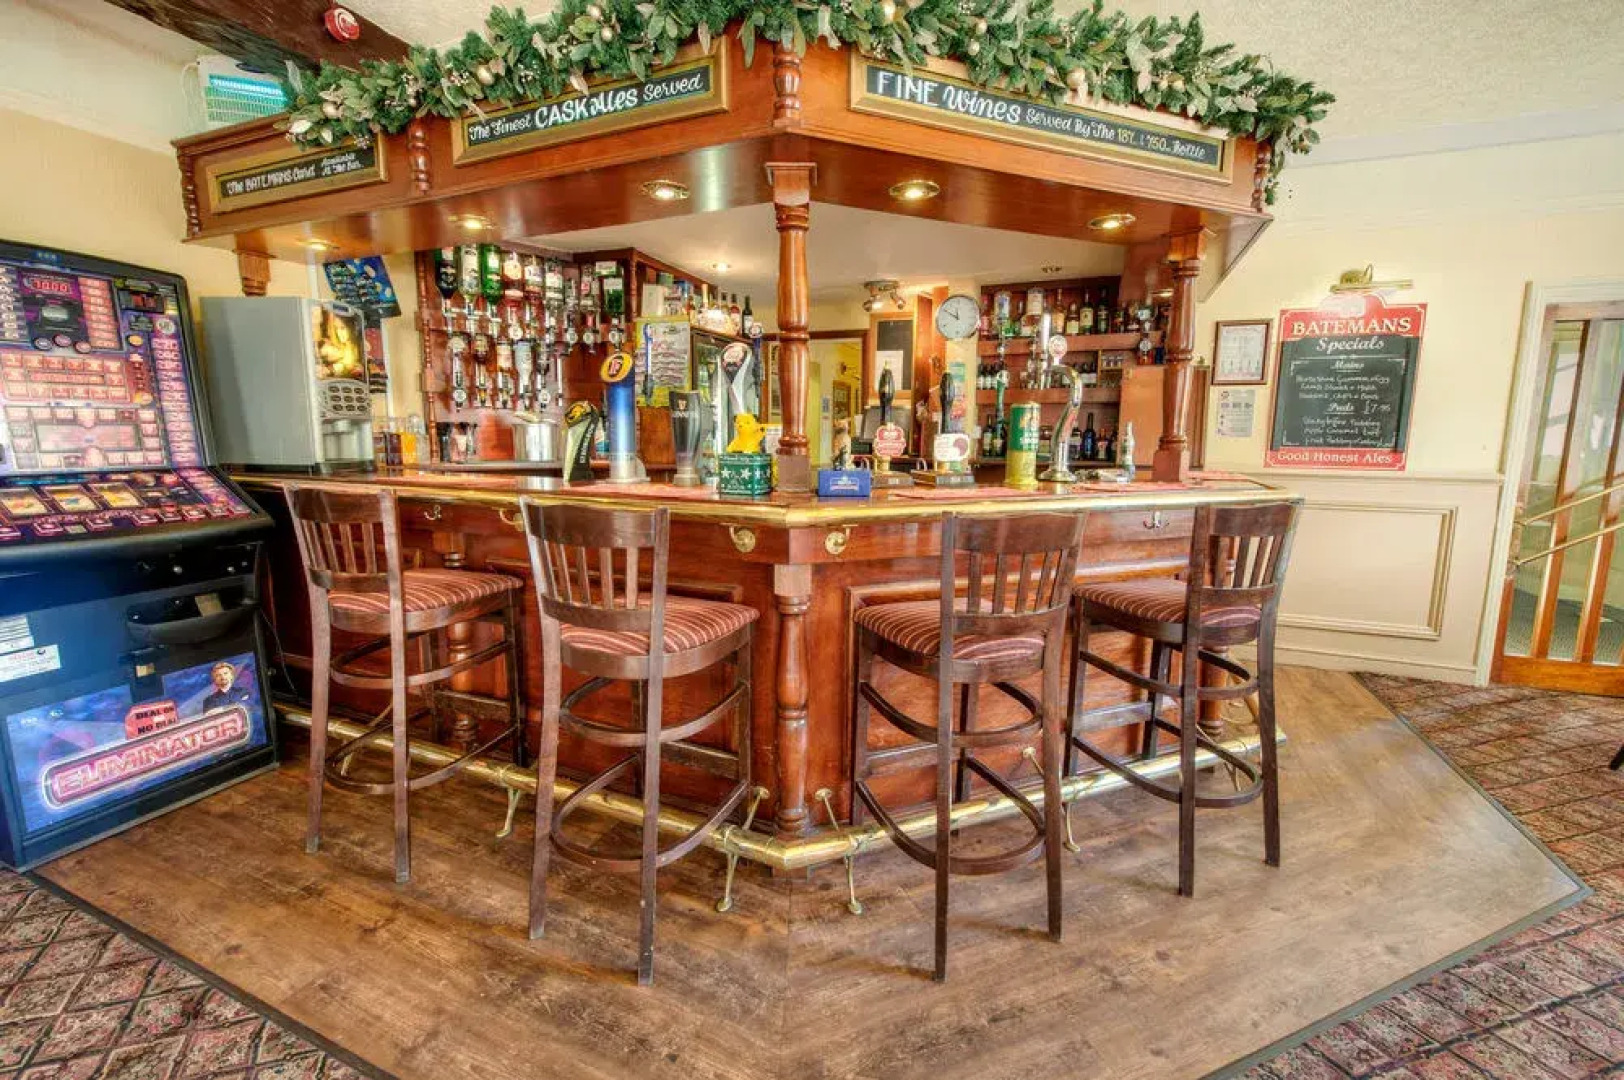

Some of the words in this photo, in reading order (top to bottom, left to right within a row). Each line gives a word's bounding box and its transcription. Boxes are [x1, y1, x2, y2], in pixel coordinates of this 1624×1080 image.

[468, 123, 490, 141] The
[490, 114, 533, 137] Finest
[534, 97, 588, 129] CASK
[643, 73, 703, 103] Served
[877, 70, 939, 107] FINE
[1026, 107, 1072, 130] Served
[1074, 117, 1091, 138] By
[1091, 121, 1115, 140] The
[227, 180, 244, 195] The
[1292, 317, 1412, 336] BATEMANS
[1316, 336, 1385, 354] Specials
[1278, 451, 1309, 462] Good
[1313, 451, 1358, 463] Honest
[1364, 452, 1393, 464] Ales
[137, 724, 153, 734] NO
[56, 717, 243, 797] ELIMINATOR
